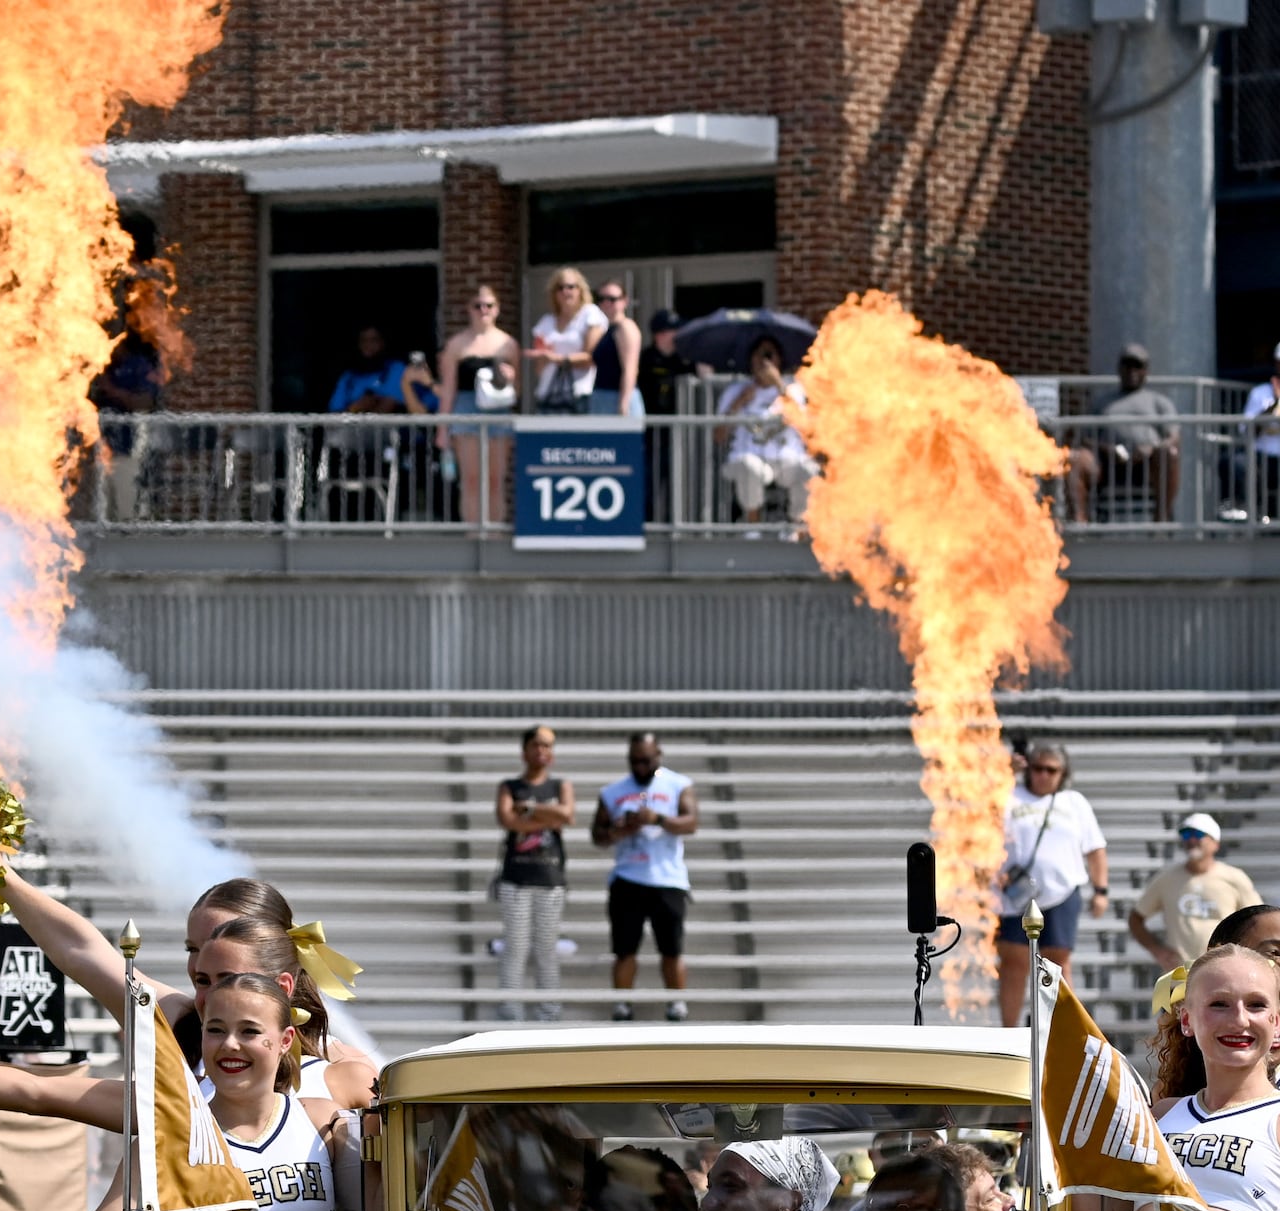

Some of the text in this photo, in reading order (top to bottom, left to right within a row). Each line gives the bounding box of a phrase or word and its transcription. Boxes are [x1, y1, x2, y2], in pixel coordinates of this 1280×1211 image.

[542, 448, 616, 464] SECTION
[532, 477, 625, 521] 120
[0, 994, 48, 1036] FX
[1059, 1034, 1112, 1149] TO
[1101, 1056, 1158, 1165] HELL
[1163, 1133, 1253, 1176] ECH
[243, 1162, 326, 1208] ECH
